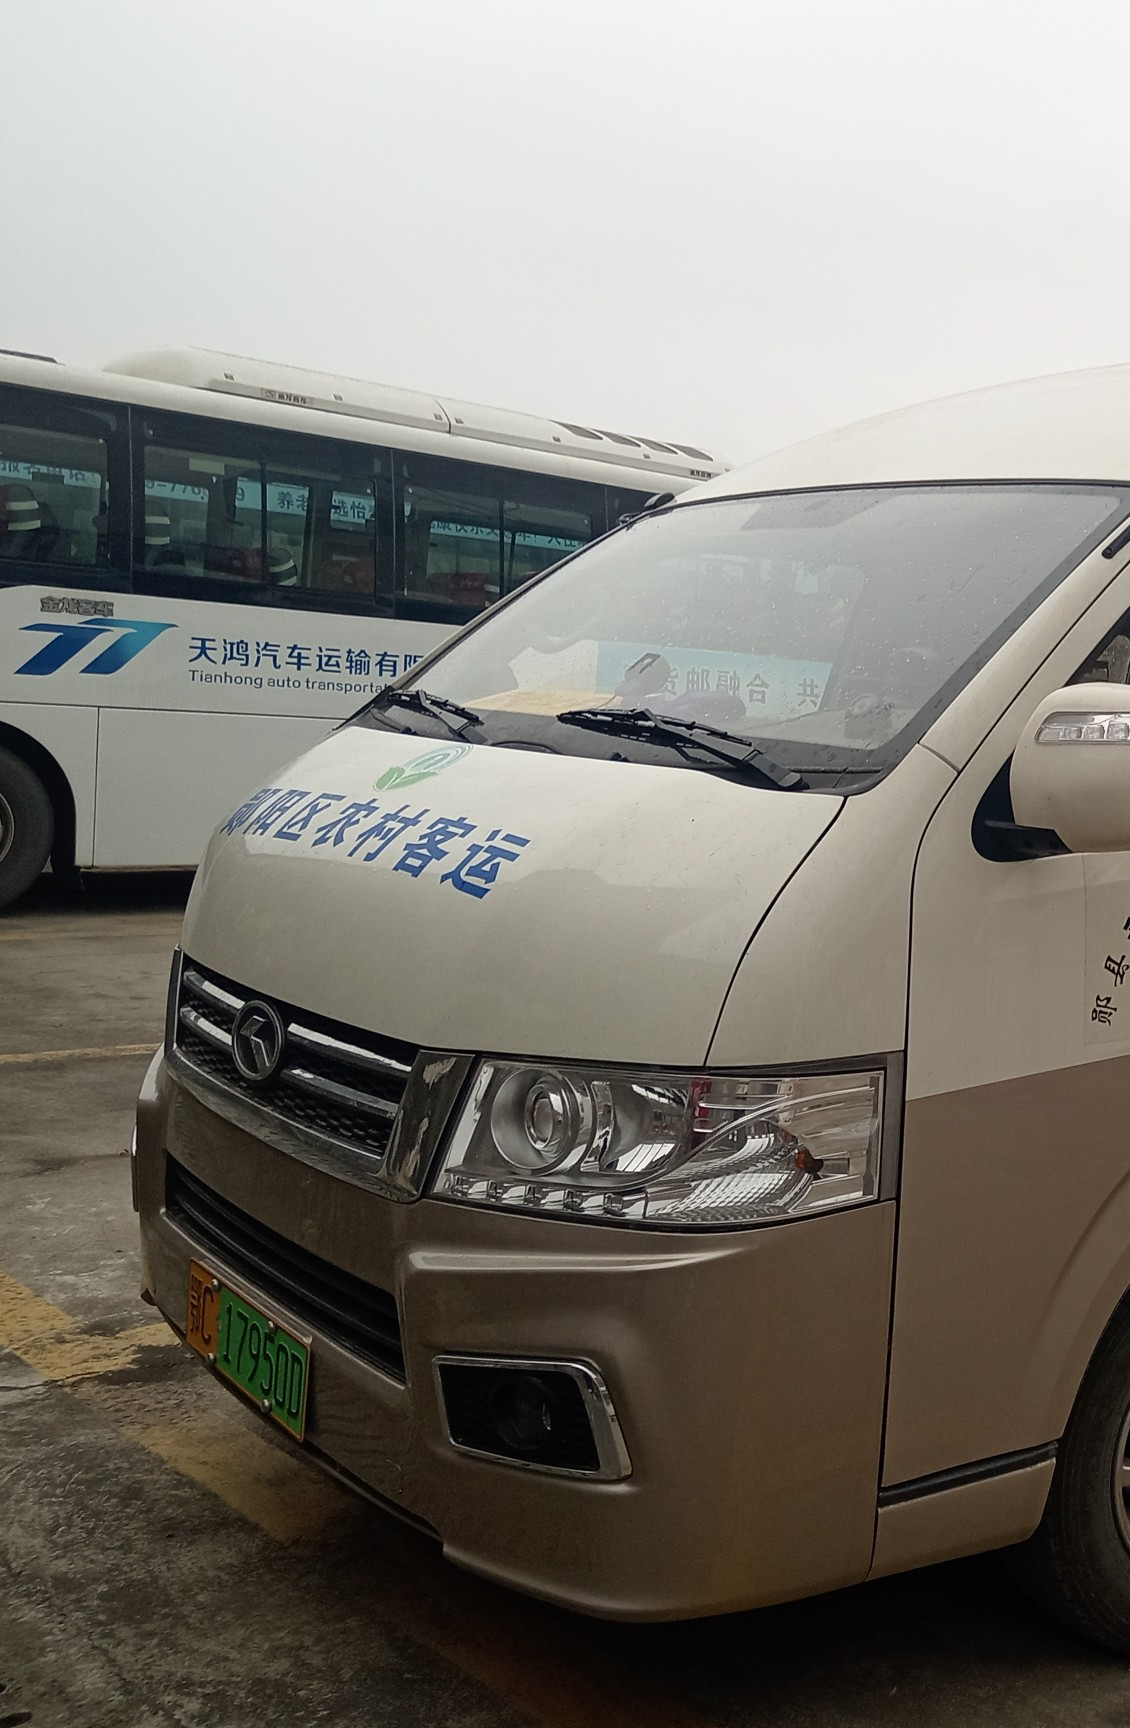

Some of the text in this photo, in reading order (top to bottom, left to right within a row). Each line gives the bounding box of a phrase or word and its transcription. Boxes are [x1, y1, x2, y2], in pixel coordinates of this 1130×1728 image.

[40, 596, 114, 617] 金龙客车
[189, 669, 263, 689] Tianhong
[267, 676, 301, 689] auto
[797, 677, 820, 708] 共
[218, 788, 531, 900] 郧阳区农村客运
